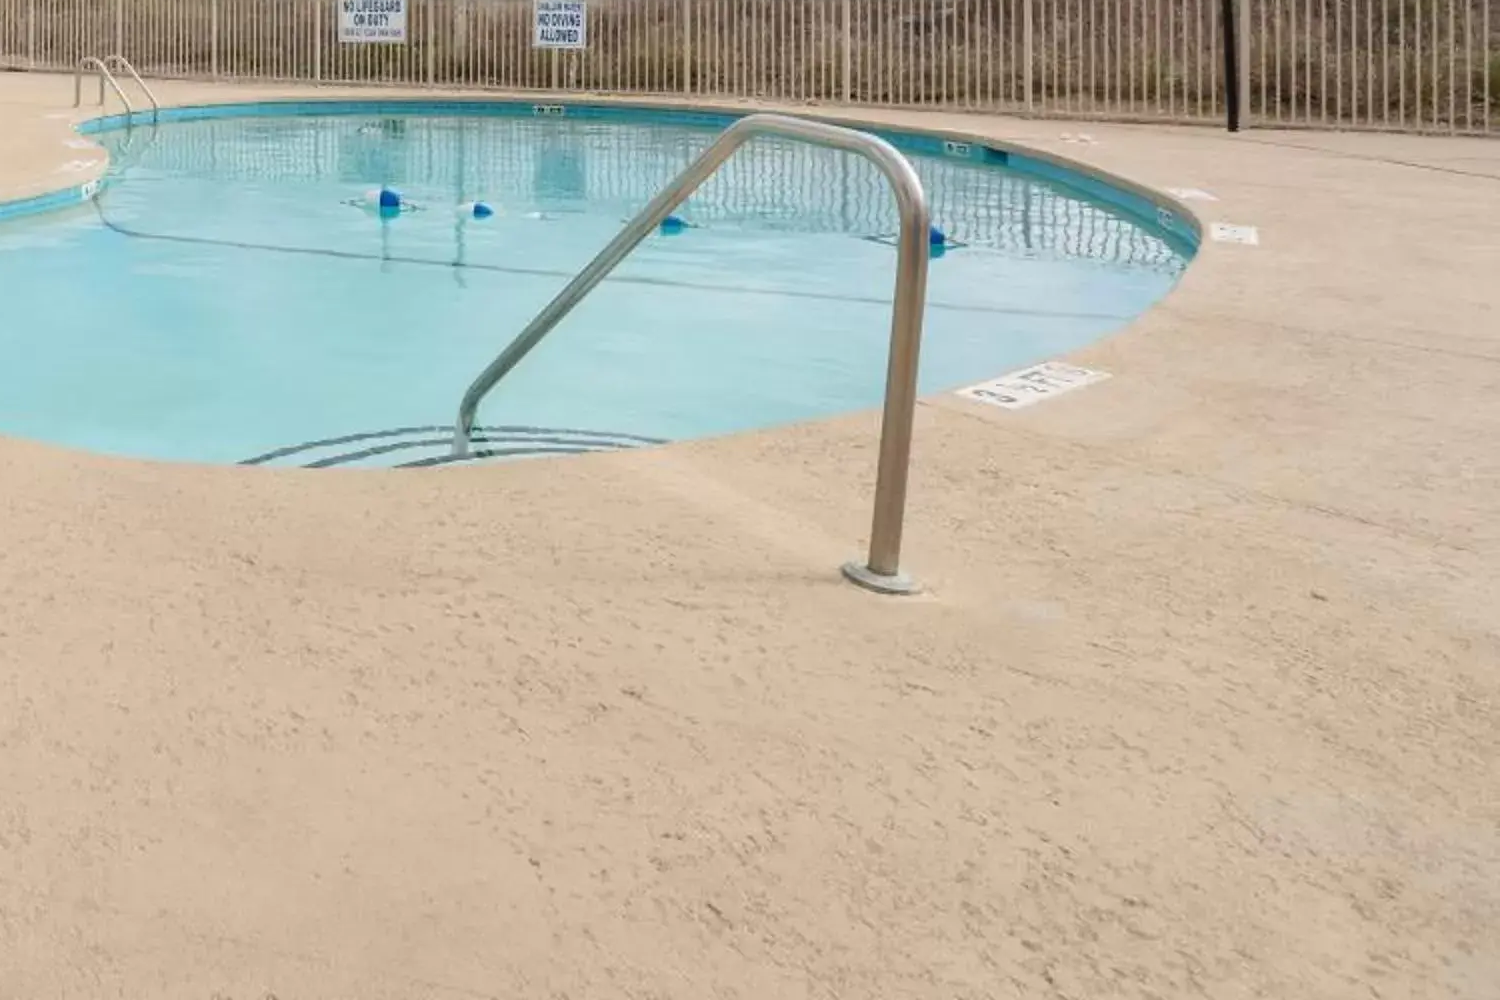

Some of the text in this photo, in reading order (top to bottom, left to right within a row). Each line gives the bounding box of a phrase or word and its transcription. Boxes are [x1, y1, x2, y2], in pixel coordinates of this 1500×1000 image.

[343, 0, 401, 13] NO LIFEGUARD
[353, 13, 389, 26] ON DUTY
[538, 13, 580, 26] NO DIVING
[540, 29, 579, 42] ALLOWED
